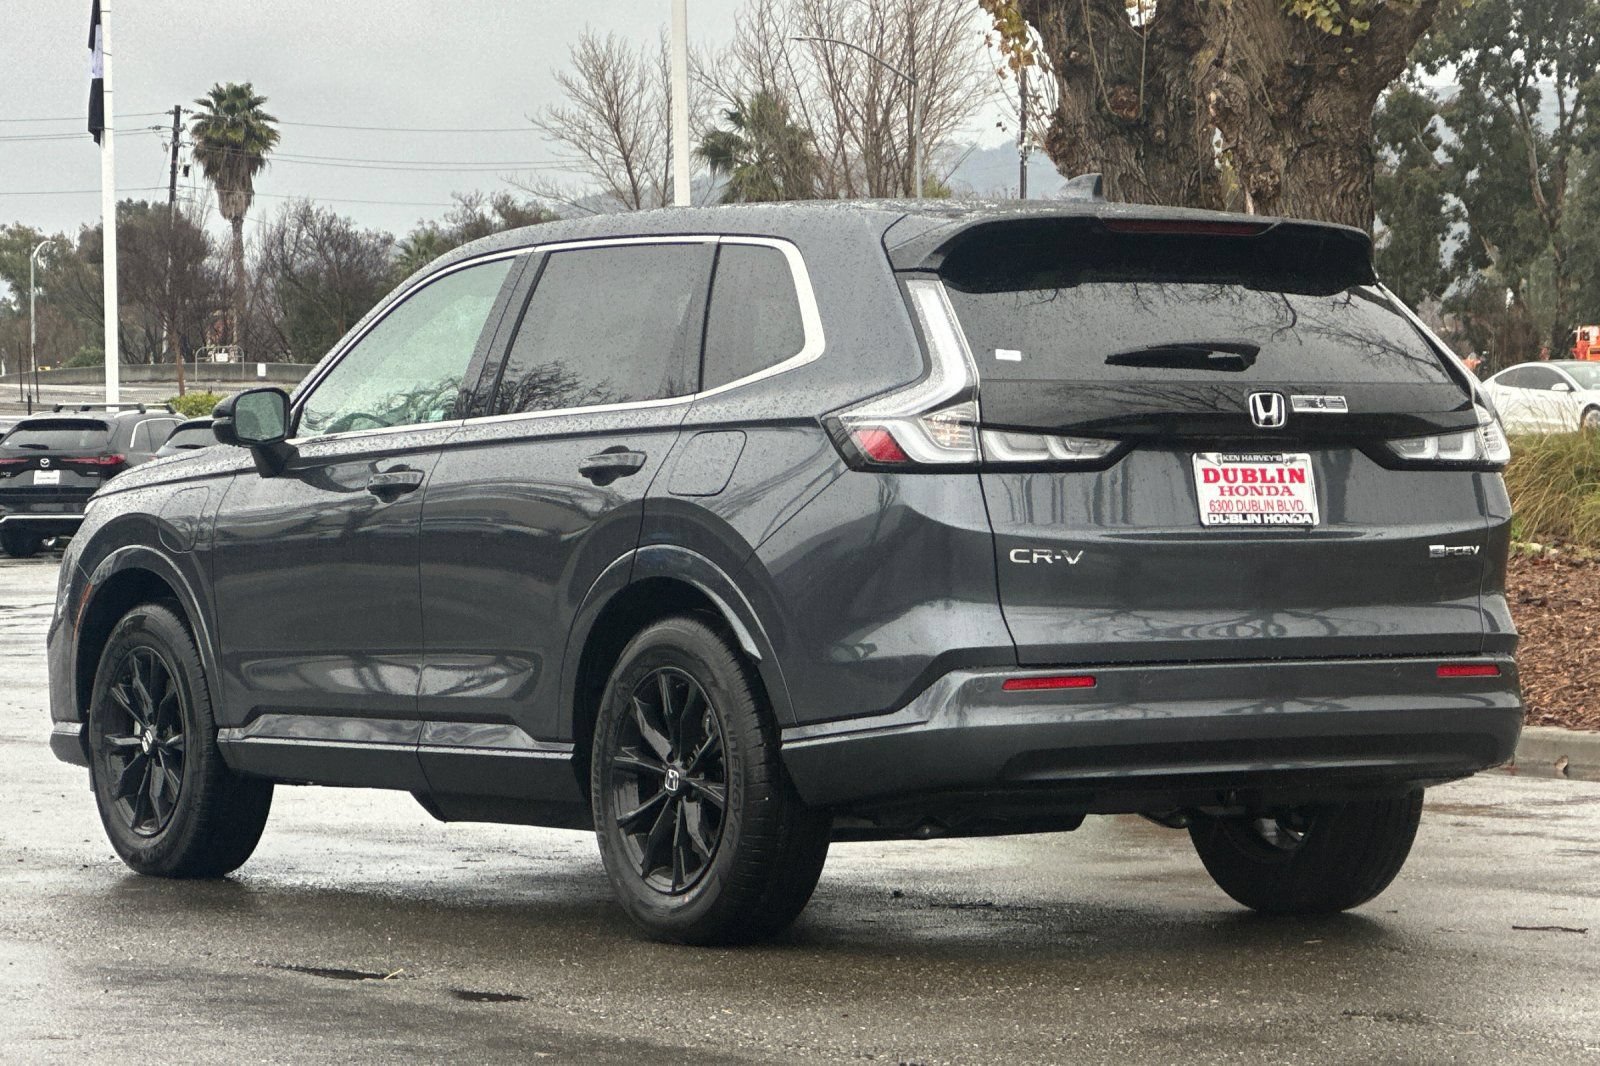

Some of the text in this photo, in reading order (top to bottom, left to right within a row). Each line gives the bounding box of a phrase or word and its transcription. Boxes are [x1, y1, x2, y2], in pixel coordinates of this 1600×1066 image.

[1222, 454, 1282, 462] KEN HARVEY'S
[1201, 467, 1306, 484] DUBLIN
[1217, 485, 1295, 497] HONDA
[1209, 499, 1307, 512] 6300 DUBLIN BLVD.
[1208, 514, 1313, 524] DUBLIN HONDA
[1009, 548, 1084, 565] CR-V
